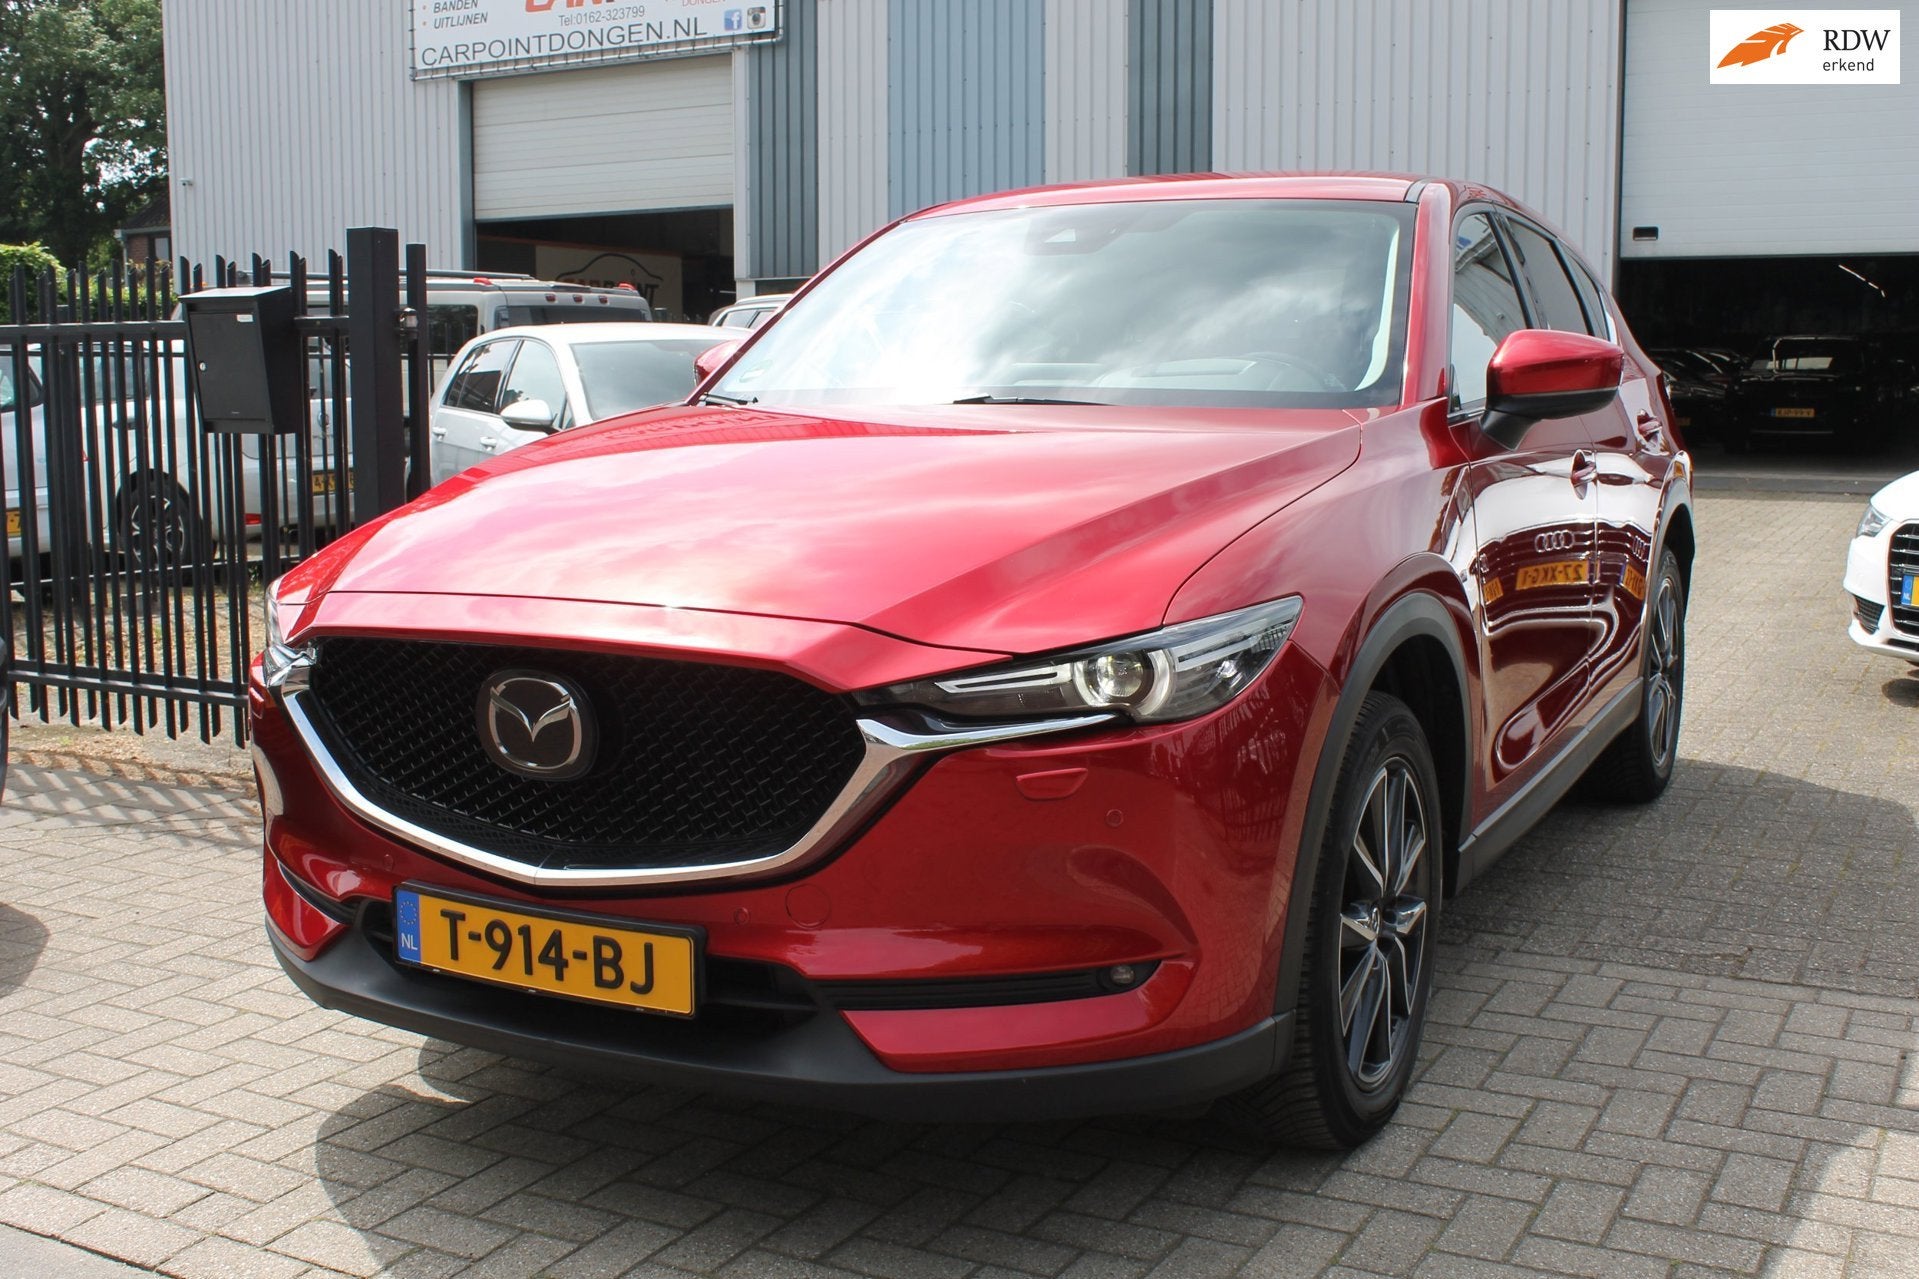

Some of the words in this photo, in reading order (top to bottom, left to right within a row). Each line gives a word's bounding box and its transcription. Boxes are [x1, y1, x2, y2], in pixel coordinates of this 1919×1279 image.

[433, 0, 479, 13] BANDEN
[559, 5, 645, 26] Tel:0162-323799
[434, 12, 489, 29] UITLIJNEN
[421, 17, 708, 66] CARPOINTDONGEN.NL
[401, 932, 418, 951] NL
[440, 908, 654, 995] T-914-BJ
